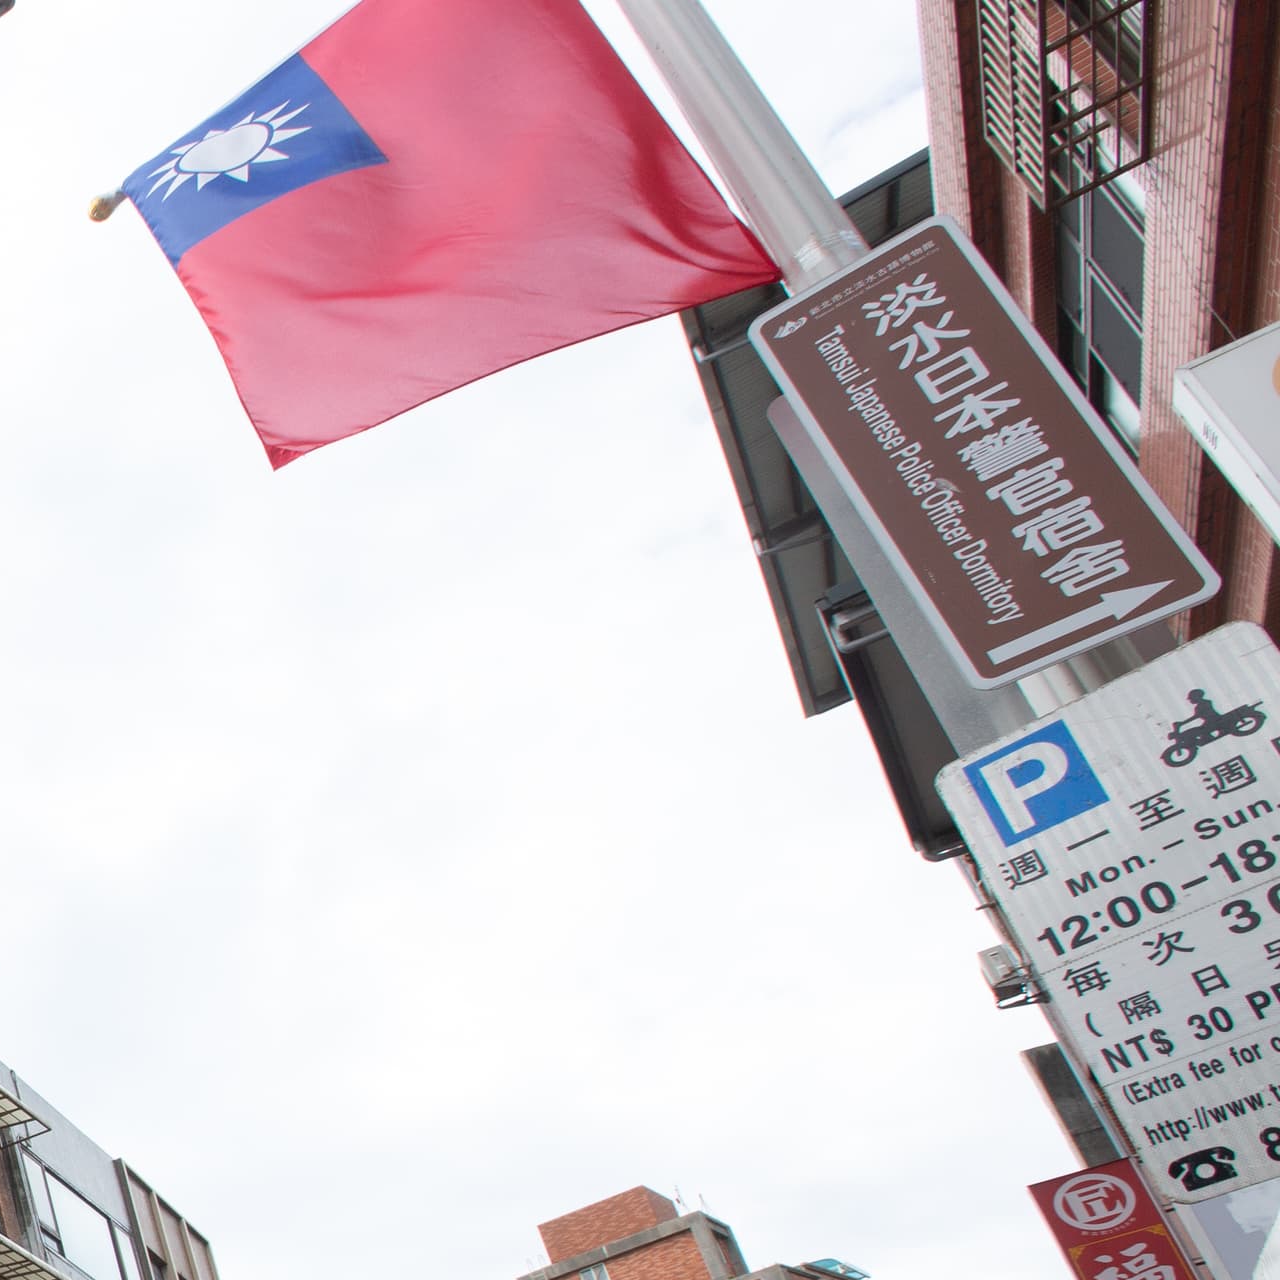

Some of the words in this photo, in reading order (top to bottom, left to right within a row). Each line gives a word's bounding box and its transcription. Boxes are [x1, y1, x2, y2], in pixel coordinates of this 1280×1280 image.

[815, 324, 870, 385] Tamsui
[845, 378, 906, 450] Japanese
[889, 441, 937, 496] Police
[920, 489, 973, 546] Officer
[953, 538, 1025, 625] Dormitory
[862, 272, 1130, 598] 淡水日本警官宿舍
[979, 741, 1068, 834] P
[998, 735, 1280, 893] 週一至週
[1065, 856, 1155, 898] Mon.
[1101, 1028, 1175, 1074] NT$
[1187, 1006, 1234, 1040] 30
[1122, 1072, 1187, 1105] (Extra
[1188, 1057, 1226, 1081] fee
[1229, 1043, 1263, 1067] for
